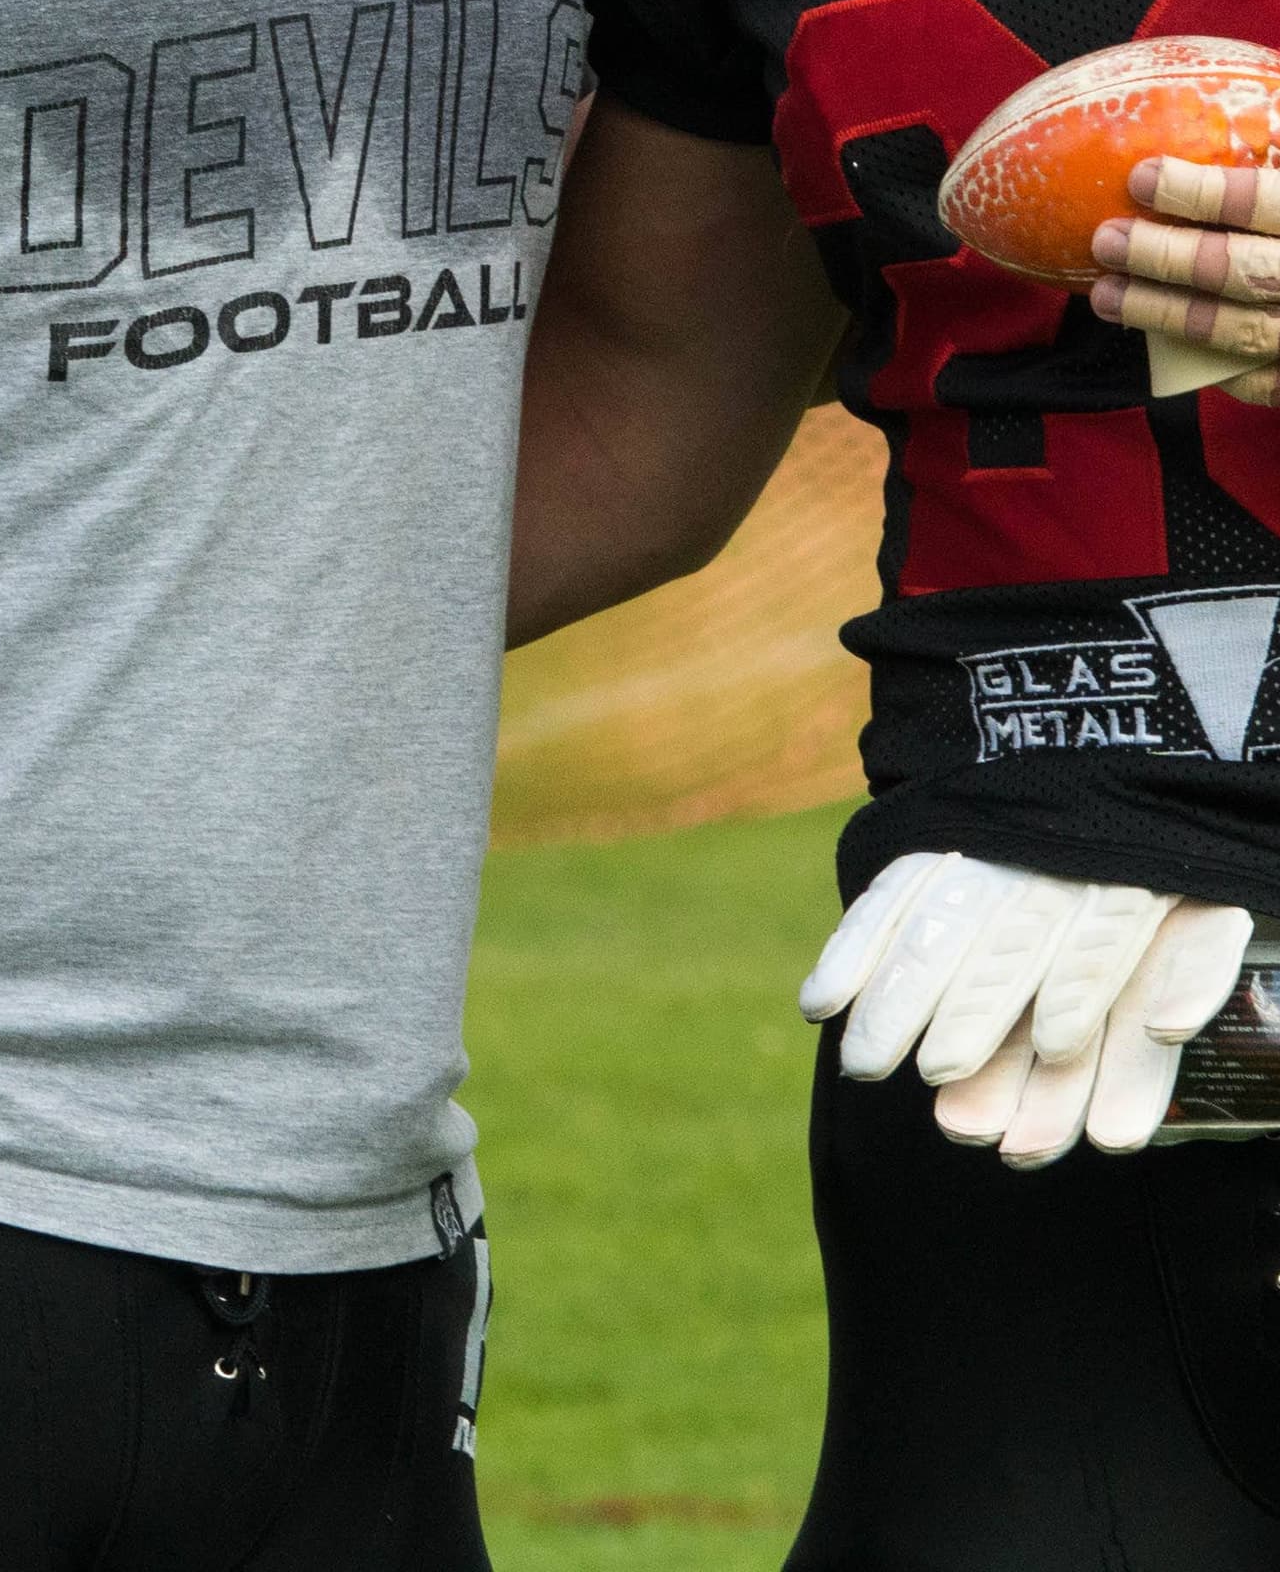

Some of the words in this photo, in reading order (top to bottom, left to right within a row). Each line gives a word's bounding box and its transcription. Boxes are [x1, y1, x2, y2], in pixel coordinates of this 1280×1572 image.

[46, 260, 527, 383] FOOTBALL
[976, 653, 1157, 696] GLAS
[984, 706, 1163, 752] METALL
